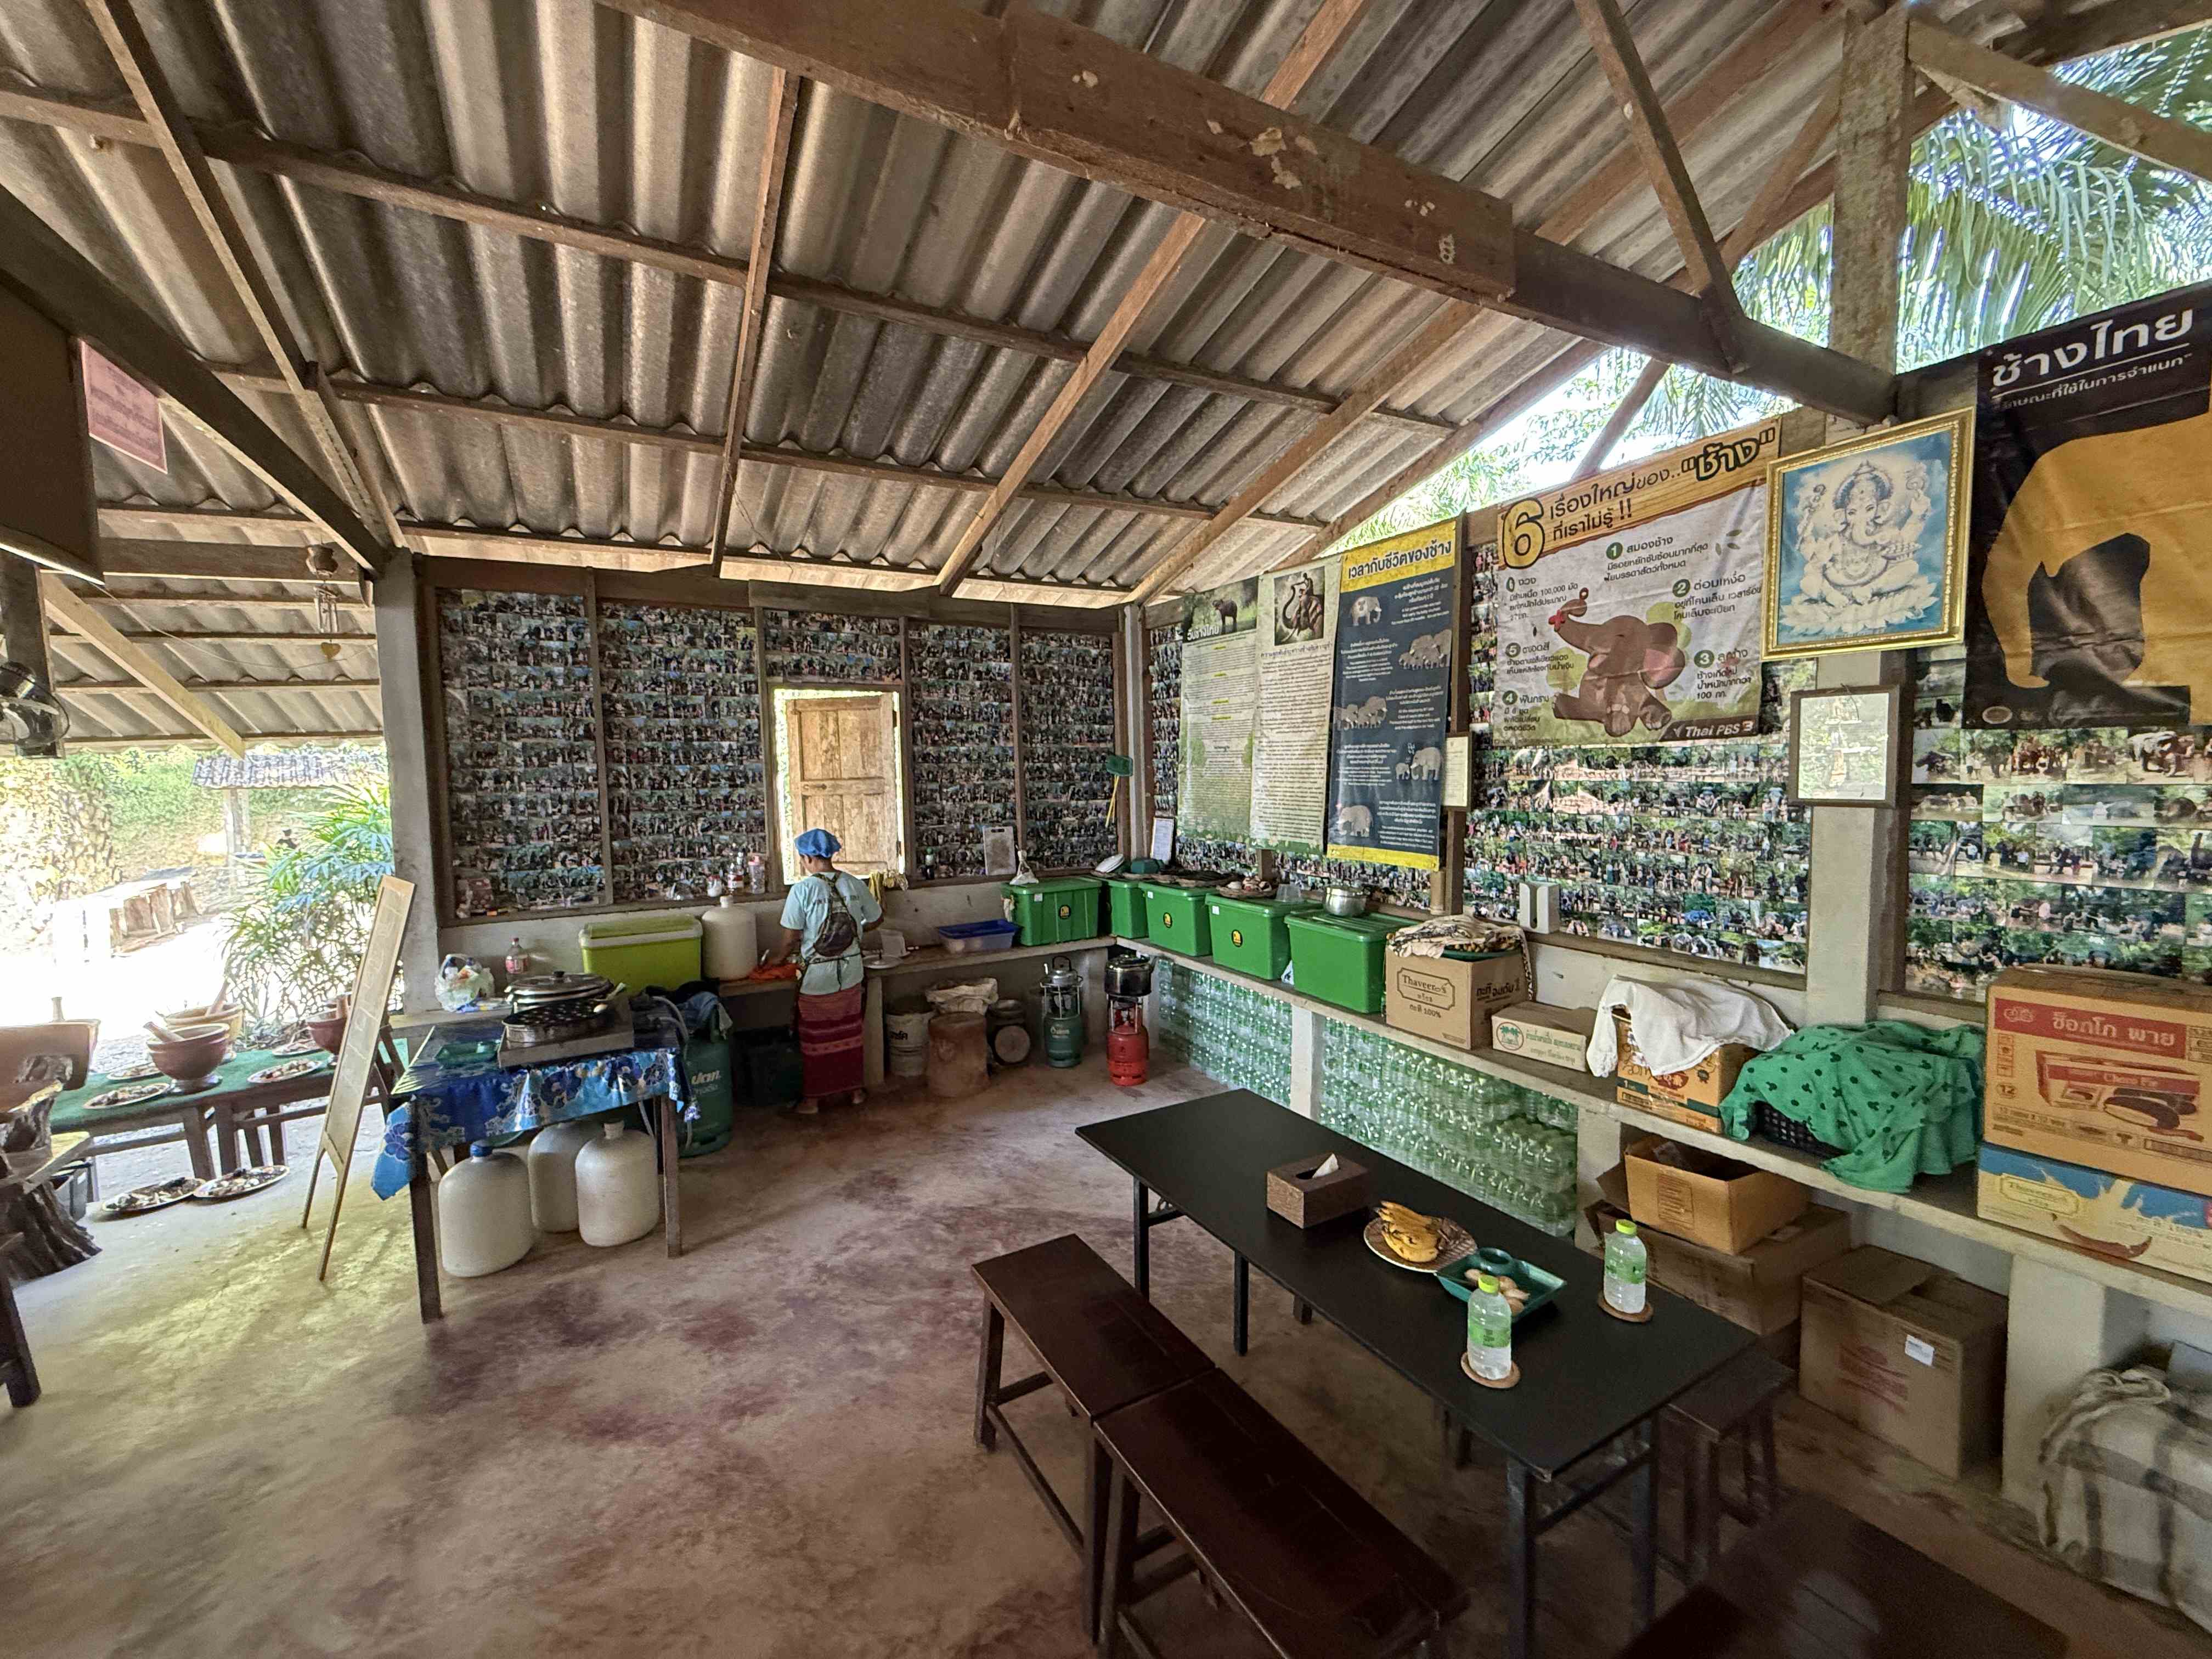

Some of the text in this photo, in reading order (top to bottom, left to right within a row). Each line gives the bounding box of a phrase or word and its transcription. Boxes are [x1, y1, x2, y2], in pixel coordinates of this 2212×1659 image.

[1992, 309, 2193, 387] ช้างไทย
[1503, 498, 1545, 569] 6
[1610, 536, 1673, 556] 1 สมองช้าง
[1348, 539, 1452, 579] เวลากับชีวิตของช้าง
[1677, 571, 1746, 594] 2 ต่อมเหงื่อ
[1509, 645, 1517, 655] 5
[1699, 652, 1710, 665] 3
[1505, 693, 1513, 703] 4
[1697, 691, 1712, 699] 100
[1685, 725, 1714, 738] Thai
[1716, 723, 1741, 736] PBS
[2128, 1026, 2175, 1047] พาย
